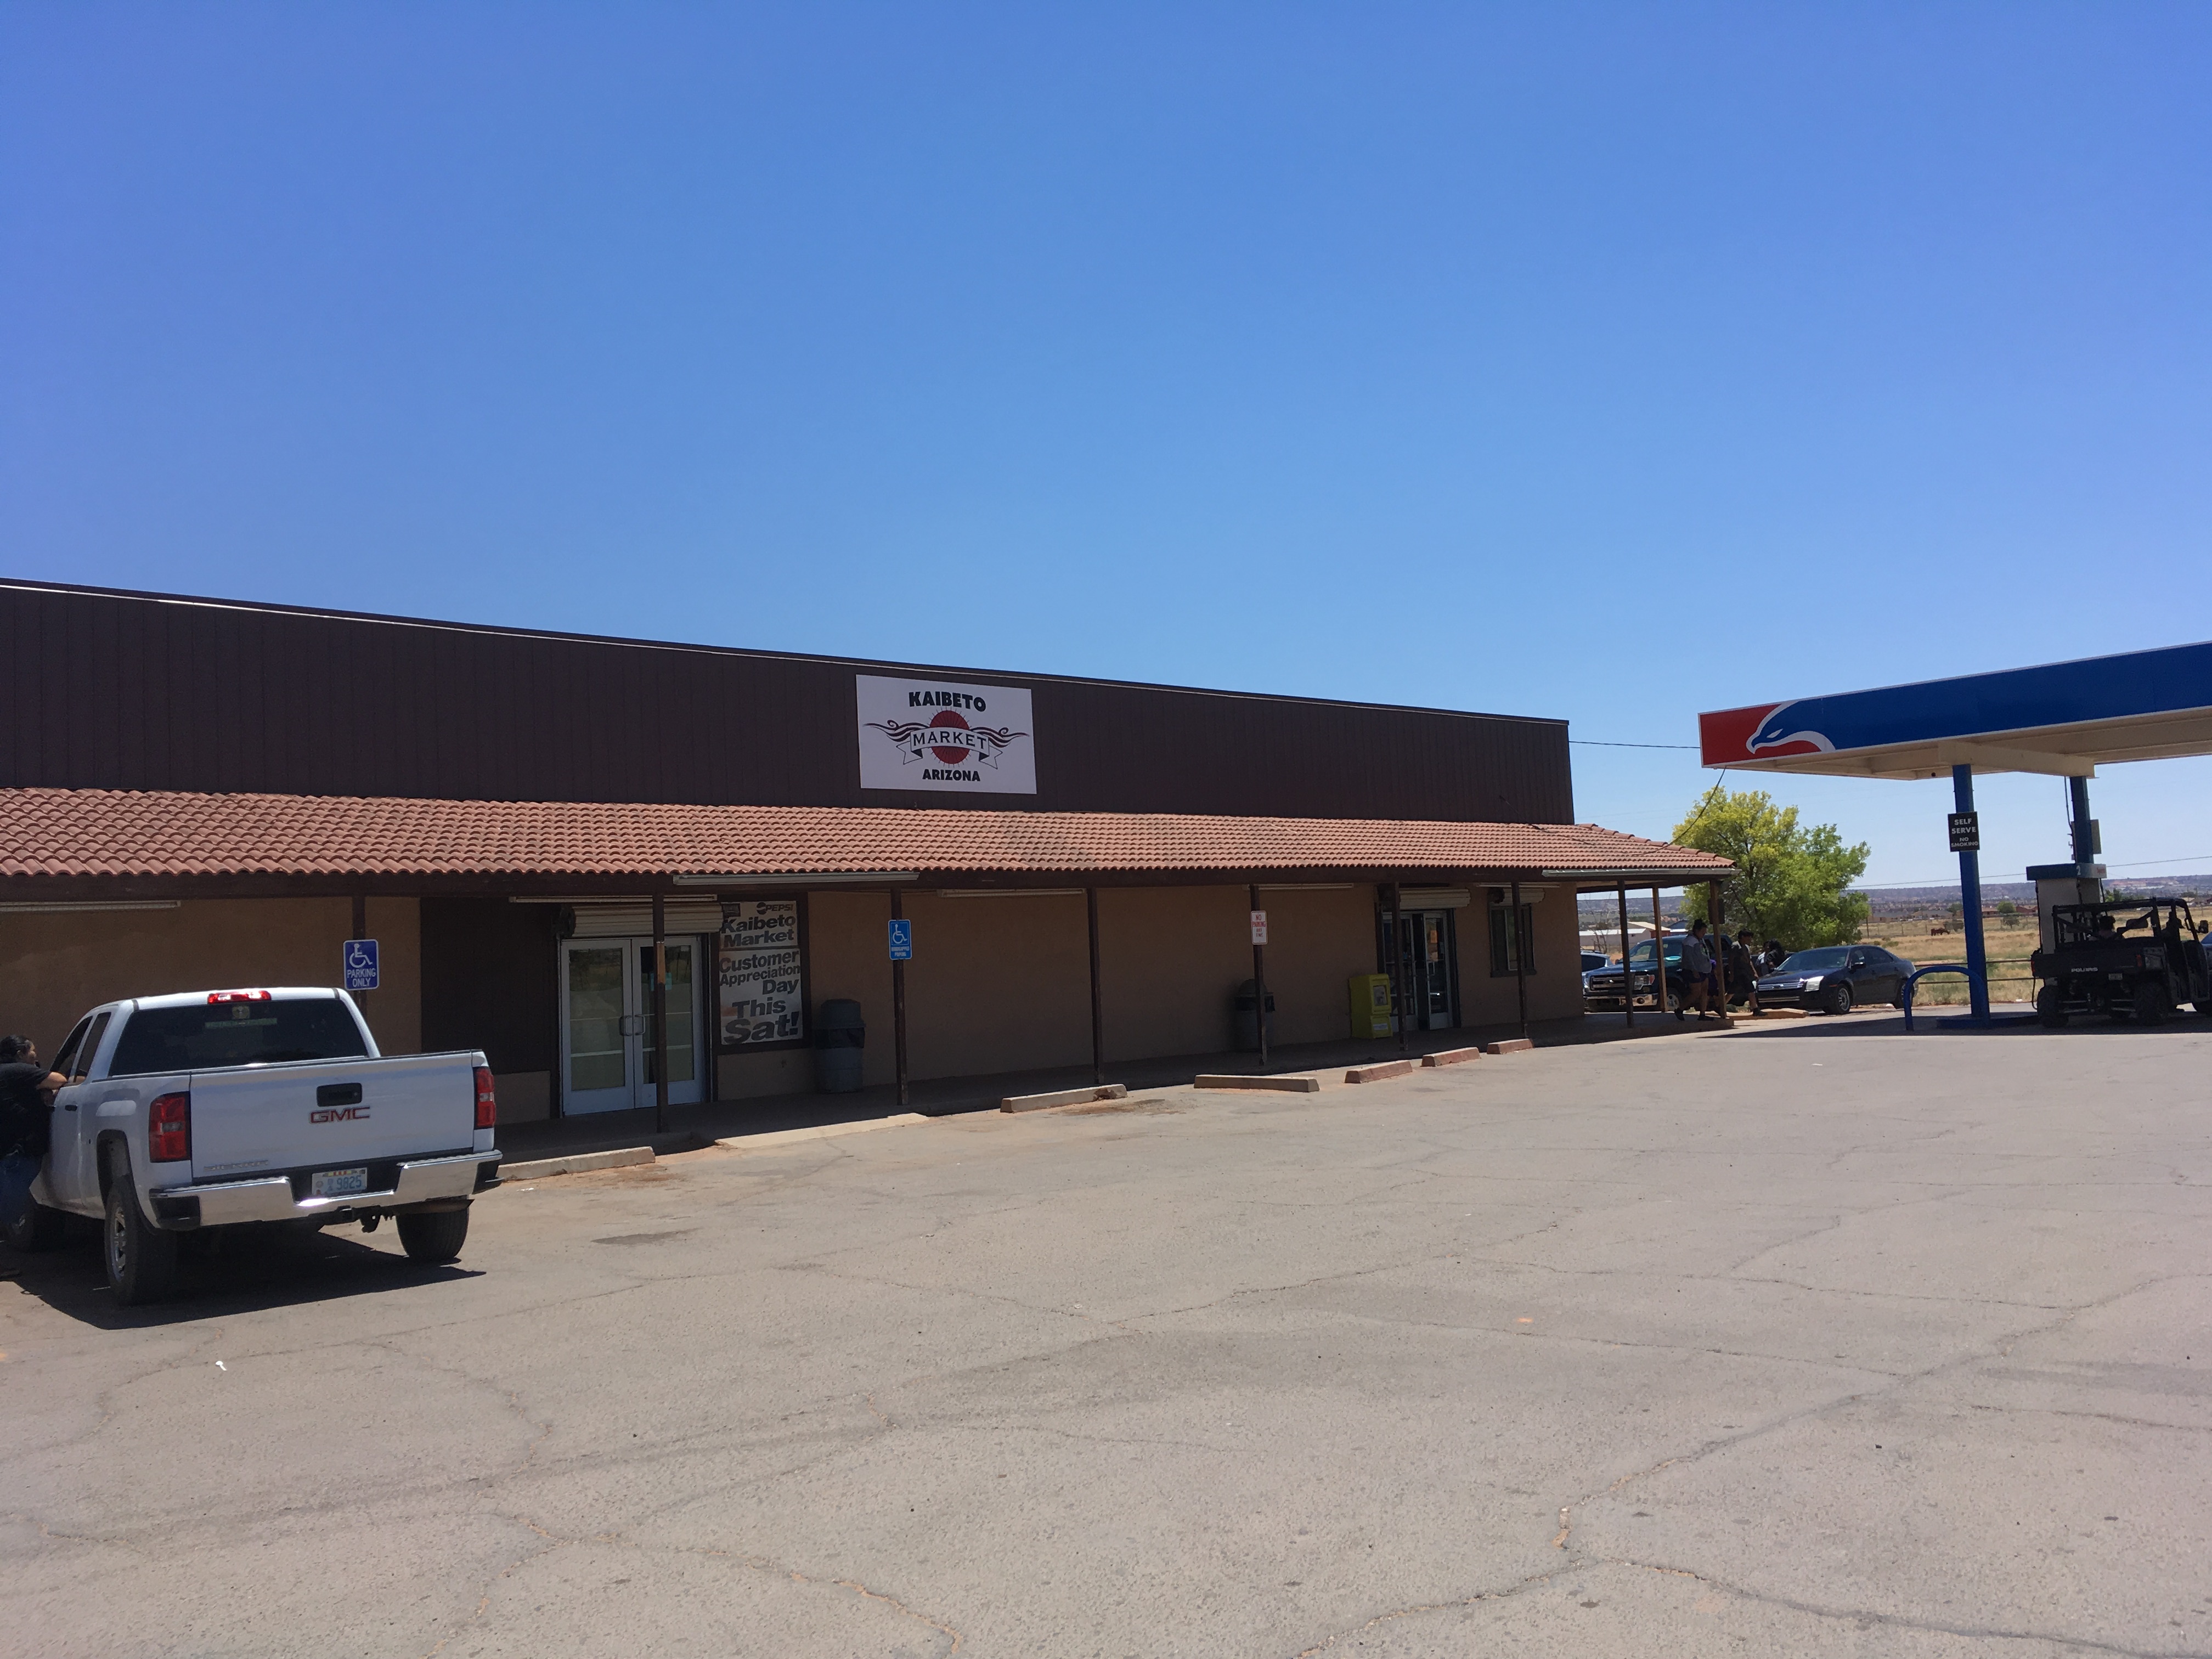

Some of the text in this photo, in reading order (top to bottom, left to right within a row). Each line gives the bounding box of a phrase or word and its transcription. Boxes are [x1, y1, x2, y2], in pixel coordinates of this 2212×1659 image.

[909, 691, 986, 712] KAIBETO
[913, 731, 988, 749] MARKET
[922, 769, 981, 782] ARIZONA
[2076, 865, 2081, 875] 2
[721, 915, 796, 933] Kaibeto
[723, 929, 794, 948] Market
[719, 950, 799, 974] Customer
[347, 968, 376, 978] PARKING
[719, 964, 800, 987] Appreciation
[352, 978, 371, 987] ONLY
[762, 979, 799, 995] Day
[732, 997, 786, 1019] This
[723, 1011, 800, 1044] Sat!
[309, 1107, 370, 1124] GMC
[336, 1175, 362, 1190] 9825
